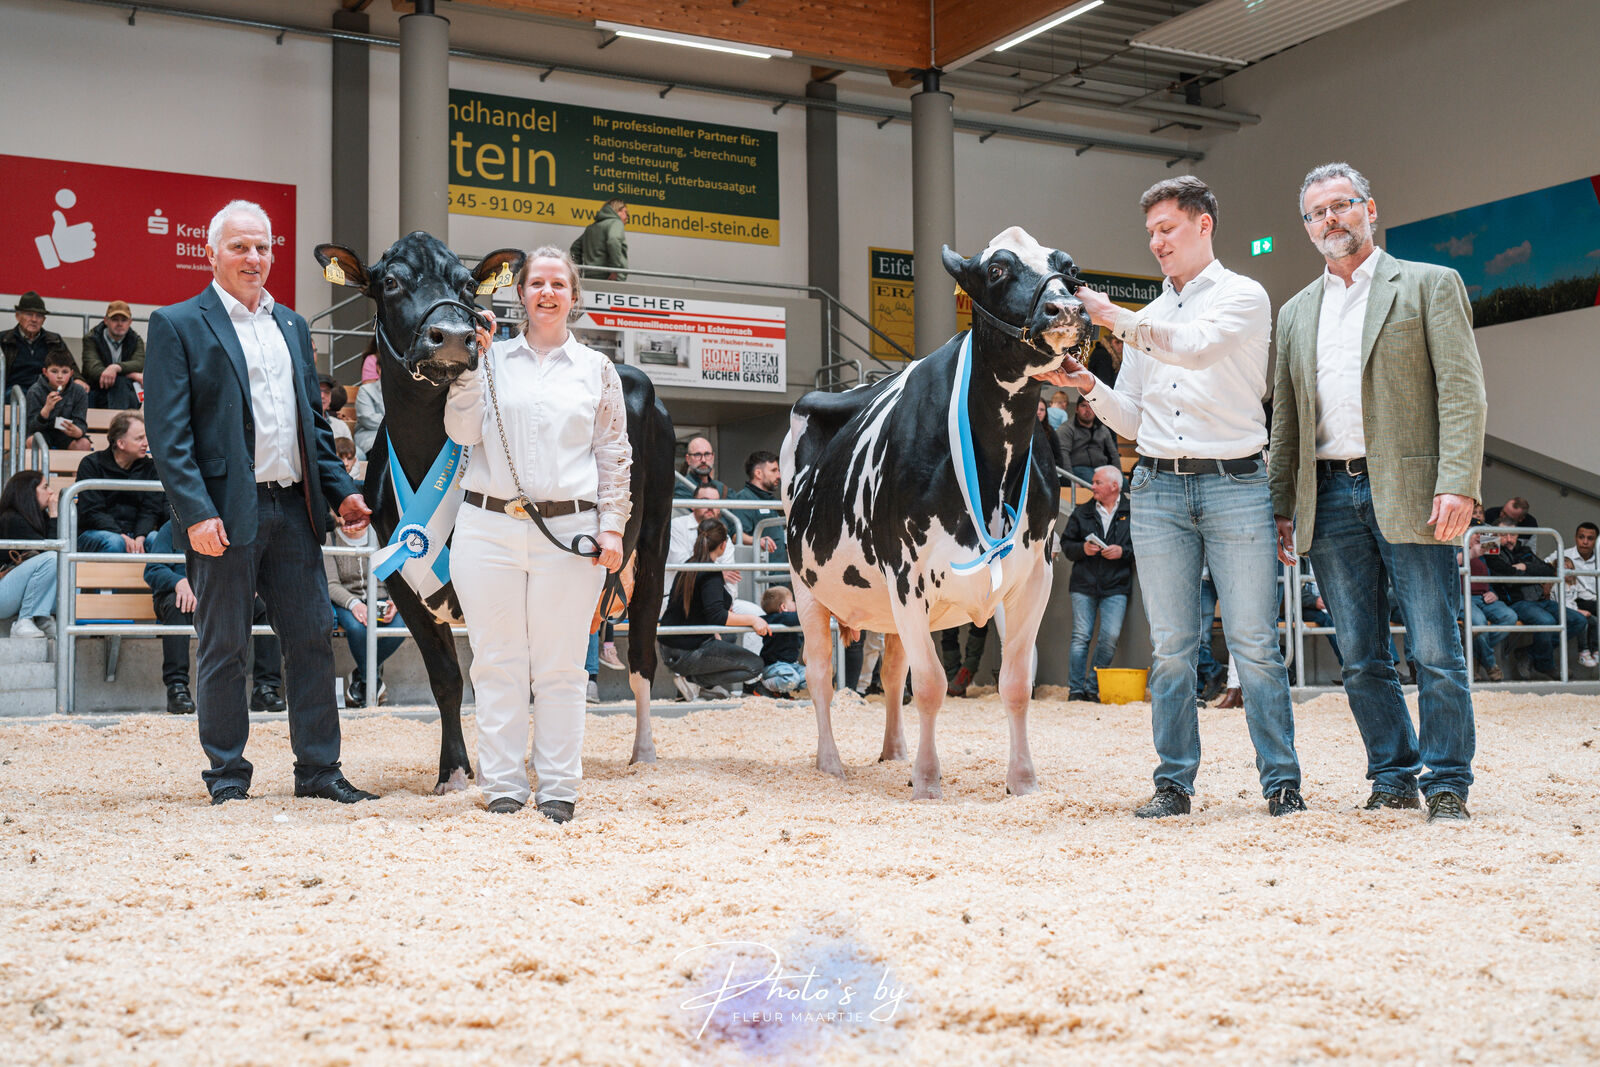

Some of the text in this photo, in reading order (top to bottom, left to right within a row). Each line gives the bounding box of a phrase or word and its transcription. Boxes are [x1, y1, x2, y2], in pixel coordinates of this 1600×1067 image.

[593, 115, 760, 147] Ihr professioneller Partner für:
[451, 131, 556, 187] tein
[593, 134, 687, 158] Rationsberatung,
[690, 146, 757, 167] -berechnung
[593, 151, 679, 172] und -betreuung
[593, 165, 662, 185] Futtermittel,
[665, 173, 757, 195] Futterbausaatgut
[593, 181, 666, 200] und Silierung
[456, 193, 477, 208] 45
[879, 256, 914, 276] Eifel
[595, 293, 685, 311] FISCHER
[604, 317, 615, 325] Im
[697, 323, 706, 332] in
[707, 325, 753, 336] Echternach
[703, 349, 740, 365] HOME
[743, 352, 779, 367] OBJEKT
[743, 372, 779, 384] GASTRO
